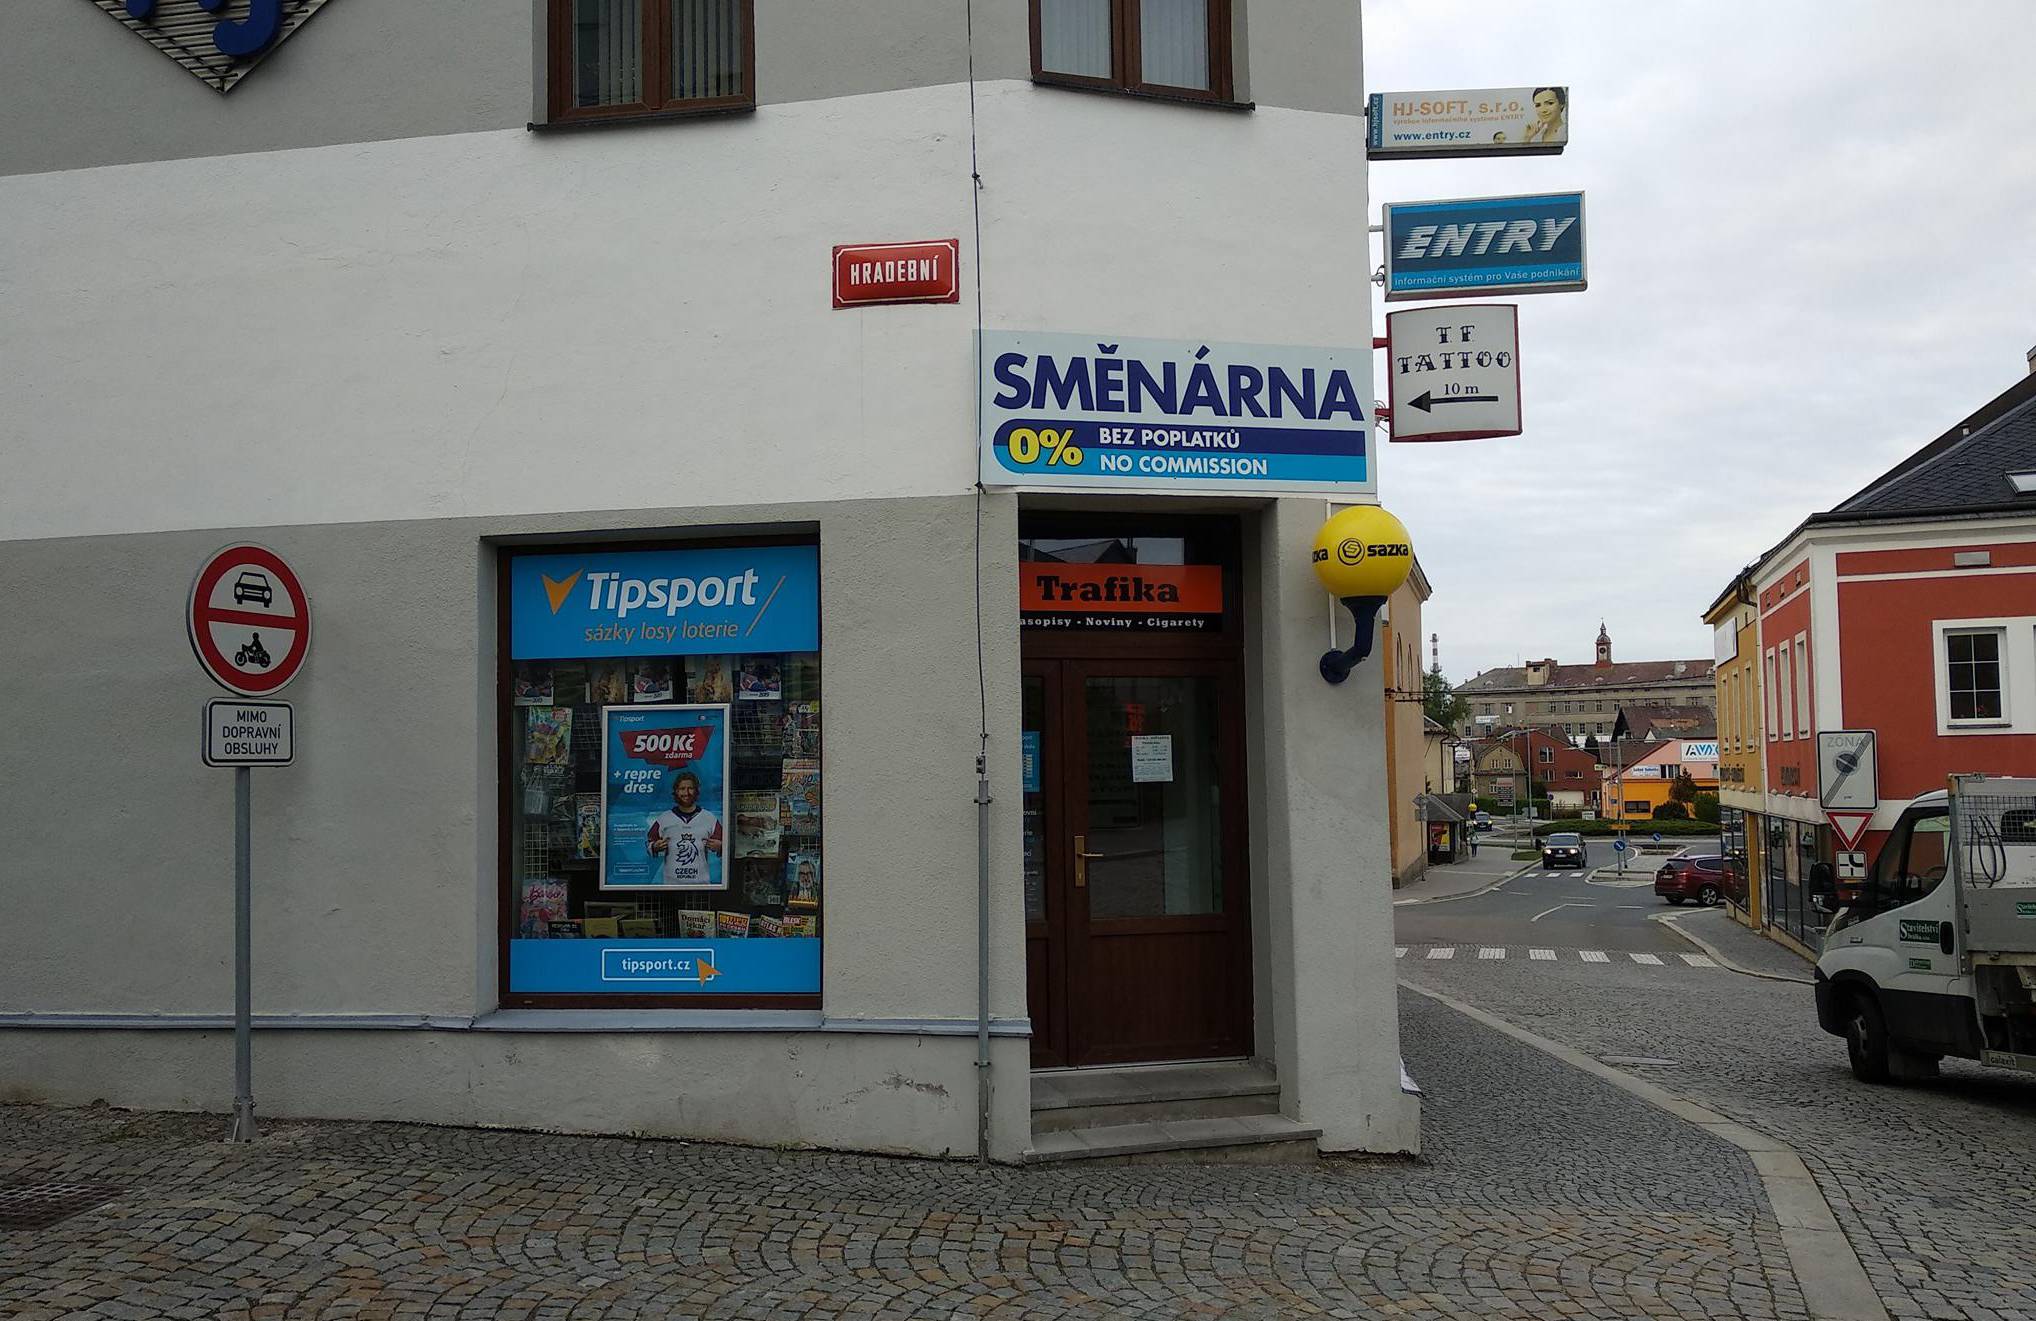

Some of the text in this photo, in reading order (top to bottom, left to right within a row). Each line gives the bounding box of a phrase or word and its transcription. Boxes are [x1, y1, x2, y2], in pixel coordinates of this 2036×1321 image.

[1478, 100, 1525, 114] s.r.o.
[1393, 130, 1471, 142] www.entry.cz
[1396, 215, 1578, 260] ENTRY
[850, 254, 939, 285] HRADEBNÍ
[1447, 273, 1484, 284] systém
[1485, 273, 1503, 283] pro
[1503, 271, 1528, 280] Vaše
[1397, 350, 1512, 375] TATTOO
[993, 342, 1365, 422] SMĚNÁRNA
[1443, 382, 1480, 395] 10 m
[1007, 426, 1240, 467] 0% BEZ POPLATKŮ
[1099, 453, 1268, 476] NO COMMISSION
[585, 567, 760, 619] Tipsport
[1036, 575, 1180, 603] Trafika
[1085, 616, 1133, 629] Noviny
[1146, 617, 1206, 629] Cigarety
[584, 619, 740, 647] sázky losy loterie
[237, 710, 267, 723] MIMO
[222, 723, 282, 740] DOPRAVNÍ
[223, 742, 279, 756] OBSLUHY
[634, 733, 696, 752] 500 Kč
[664, 752, 693, 760] zdarma
[624, 769, 661, 783] repre
[624, 781, 654, 793] dres
[621, 957, 691, 975] tipsport.cz
